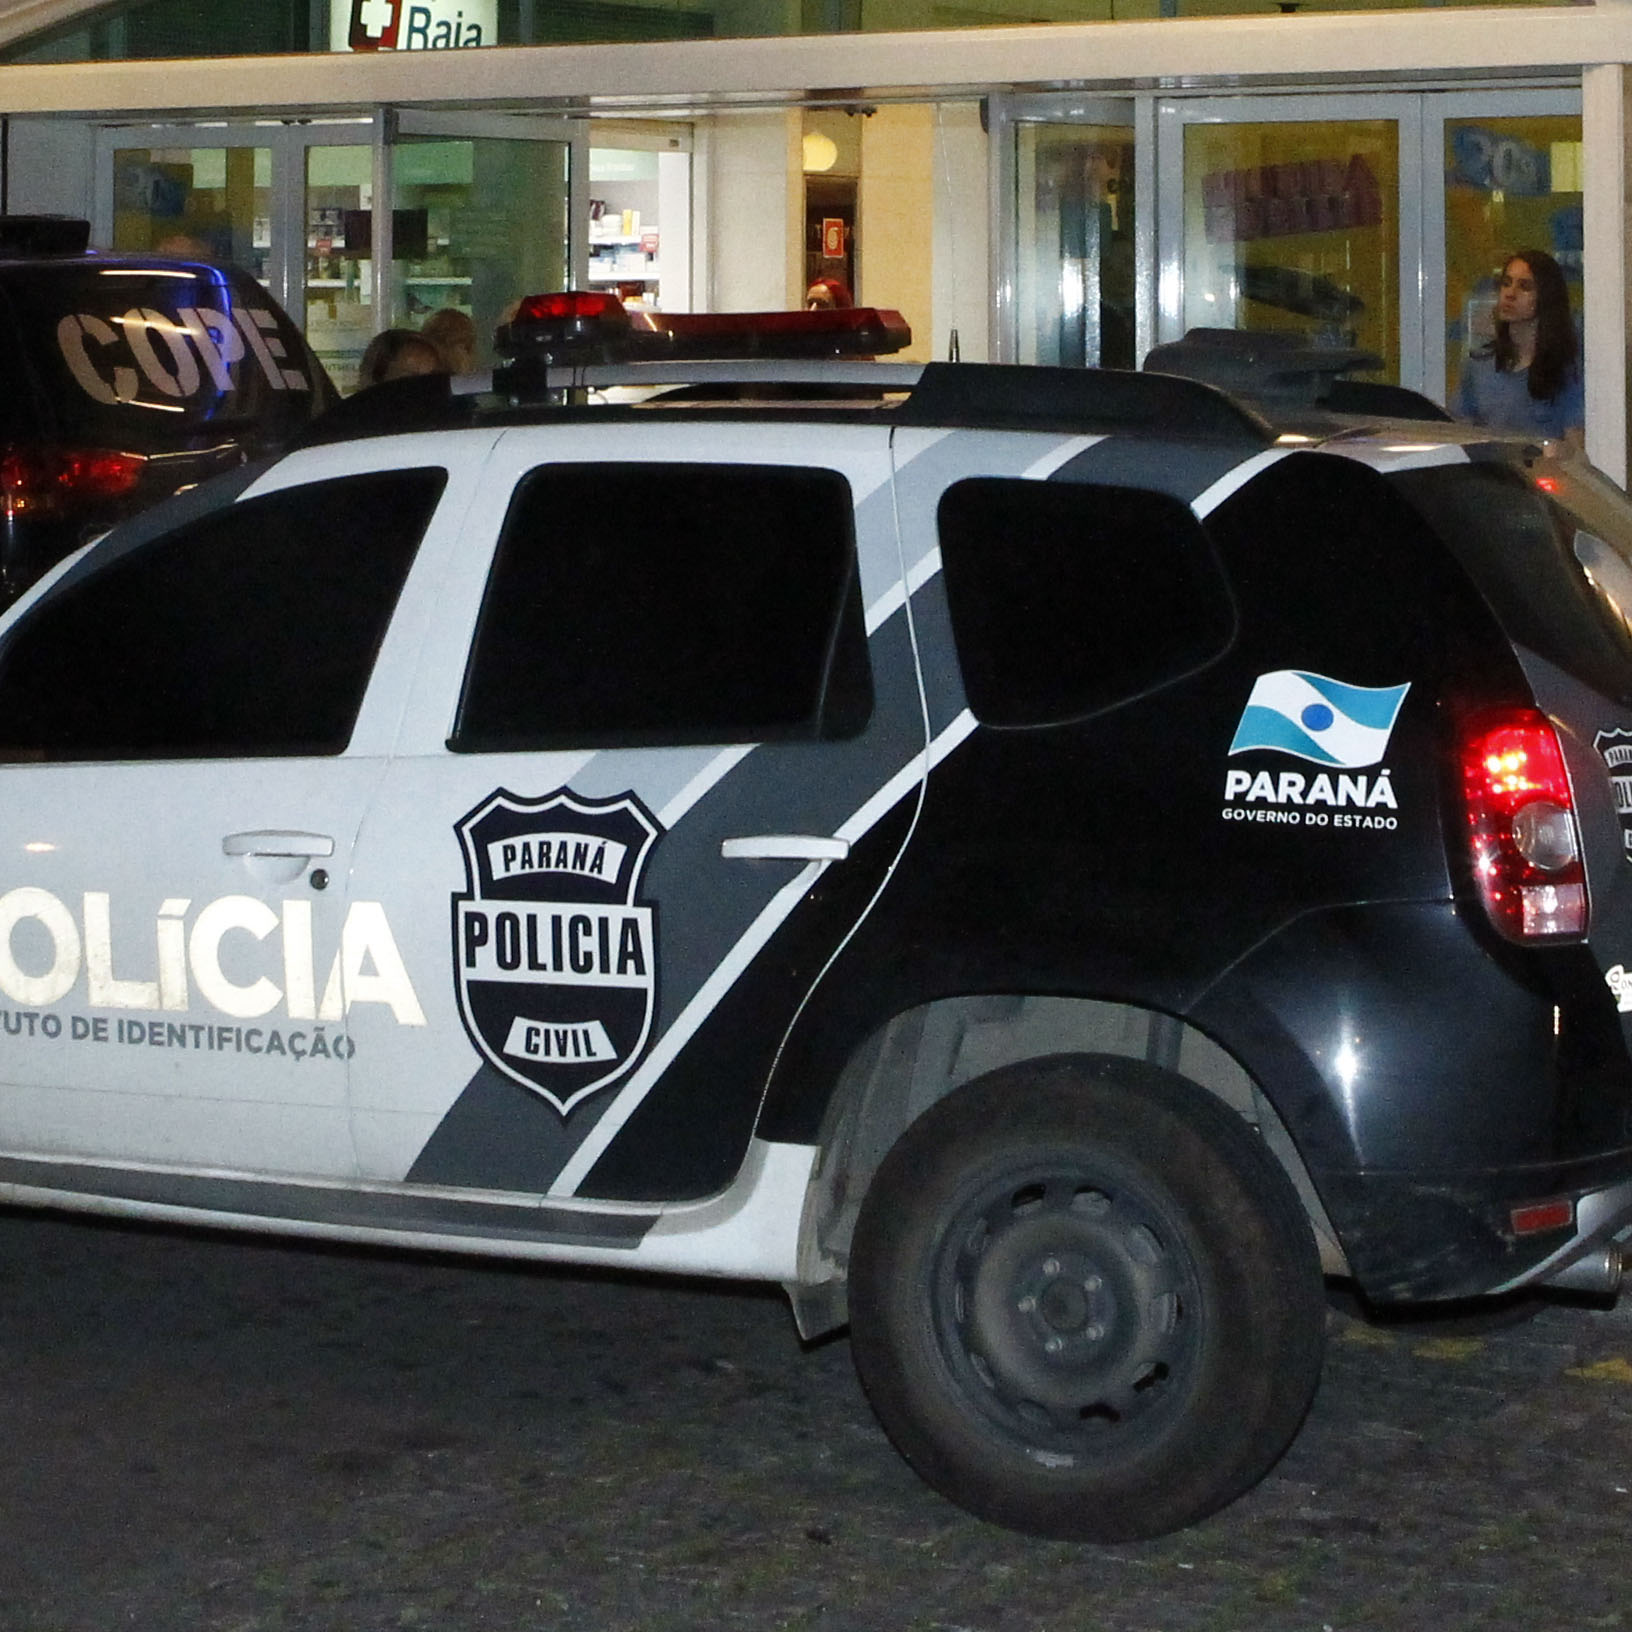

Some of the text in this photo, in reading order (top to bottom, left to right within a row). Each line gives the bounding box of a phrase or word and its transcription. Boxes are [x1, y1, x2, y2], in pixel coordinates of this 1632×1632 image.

[407, 5, 483, 50] Raia
[57, 308, 308, 405] COPE
[1224, 769, 1398, 808] PARANÁ
[1222, 808, 1398, 830] GOVERNO DO ESTADO
[503, 840, 607, 875] PARANÁ
[465, 911, 647, 976] POLICIA
[71, 1014, 109, 1044] DE
[117, 1017, 355, 1061] IDENTIFICAÇÃO
[525, 1026, 597, 1058] CIVIL
